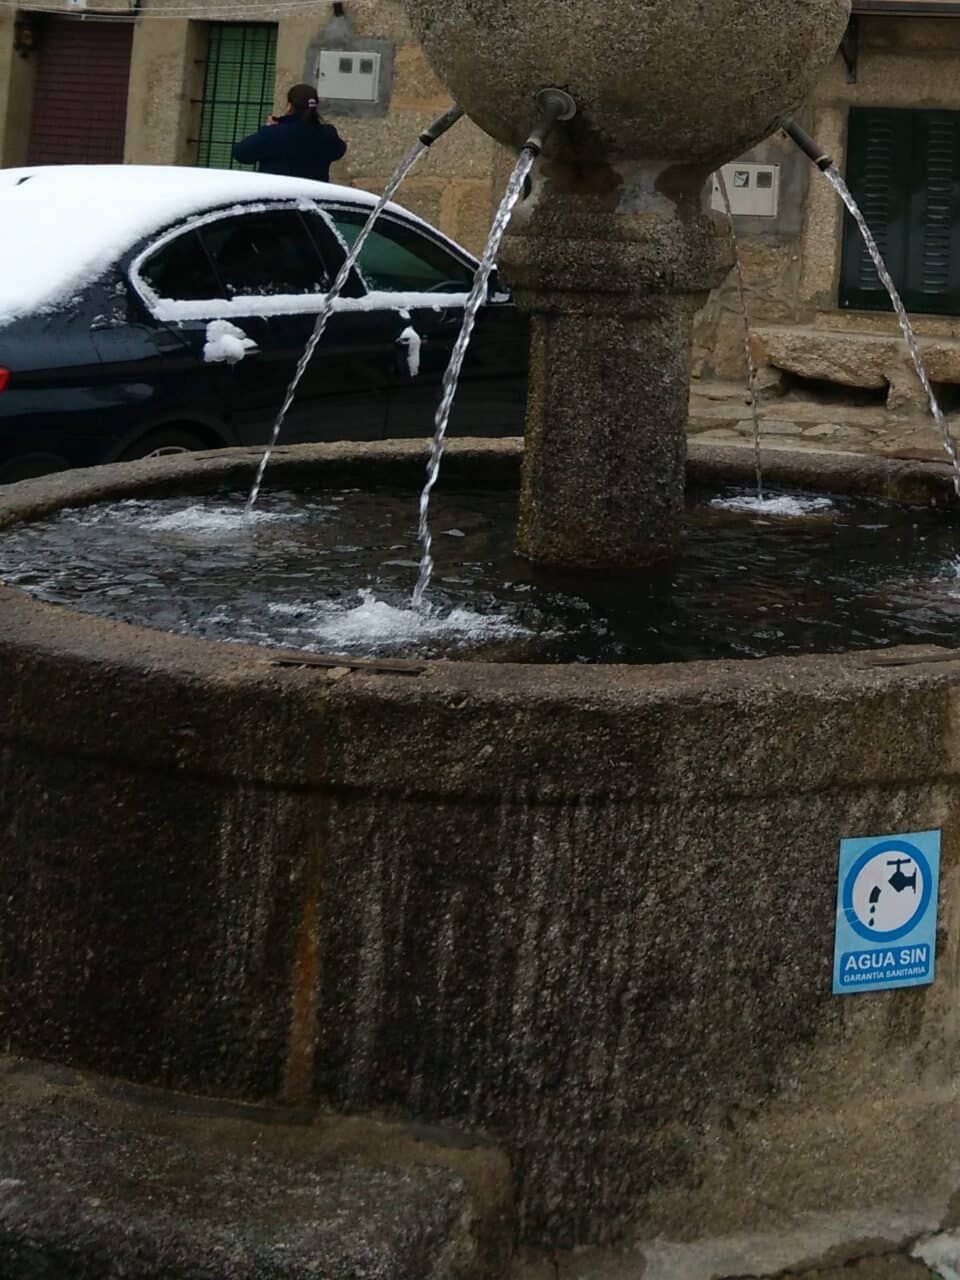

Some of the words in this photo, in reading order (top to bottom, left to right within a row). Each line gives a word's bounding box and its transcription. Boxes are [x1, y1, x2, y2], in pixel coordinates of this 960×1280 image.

[845, 951, 896, 971] AGUA
[900, 946, 927, 965] SIN
[886, 965, 926, 978] SANITARIA
